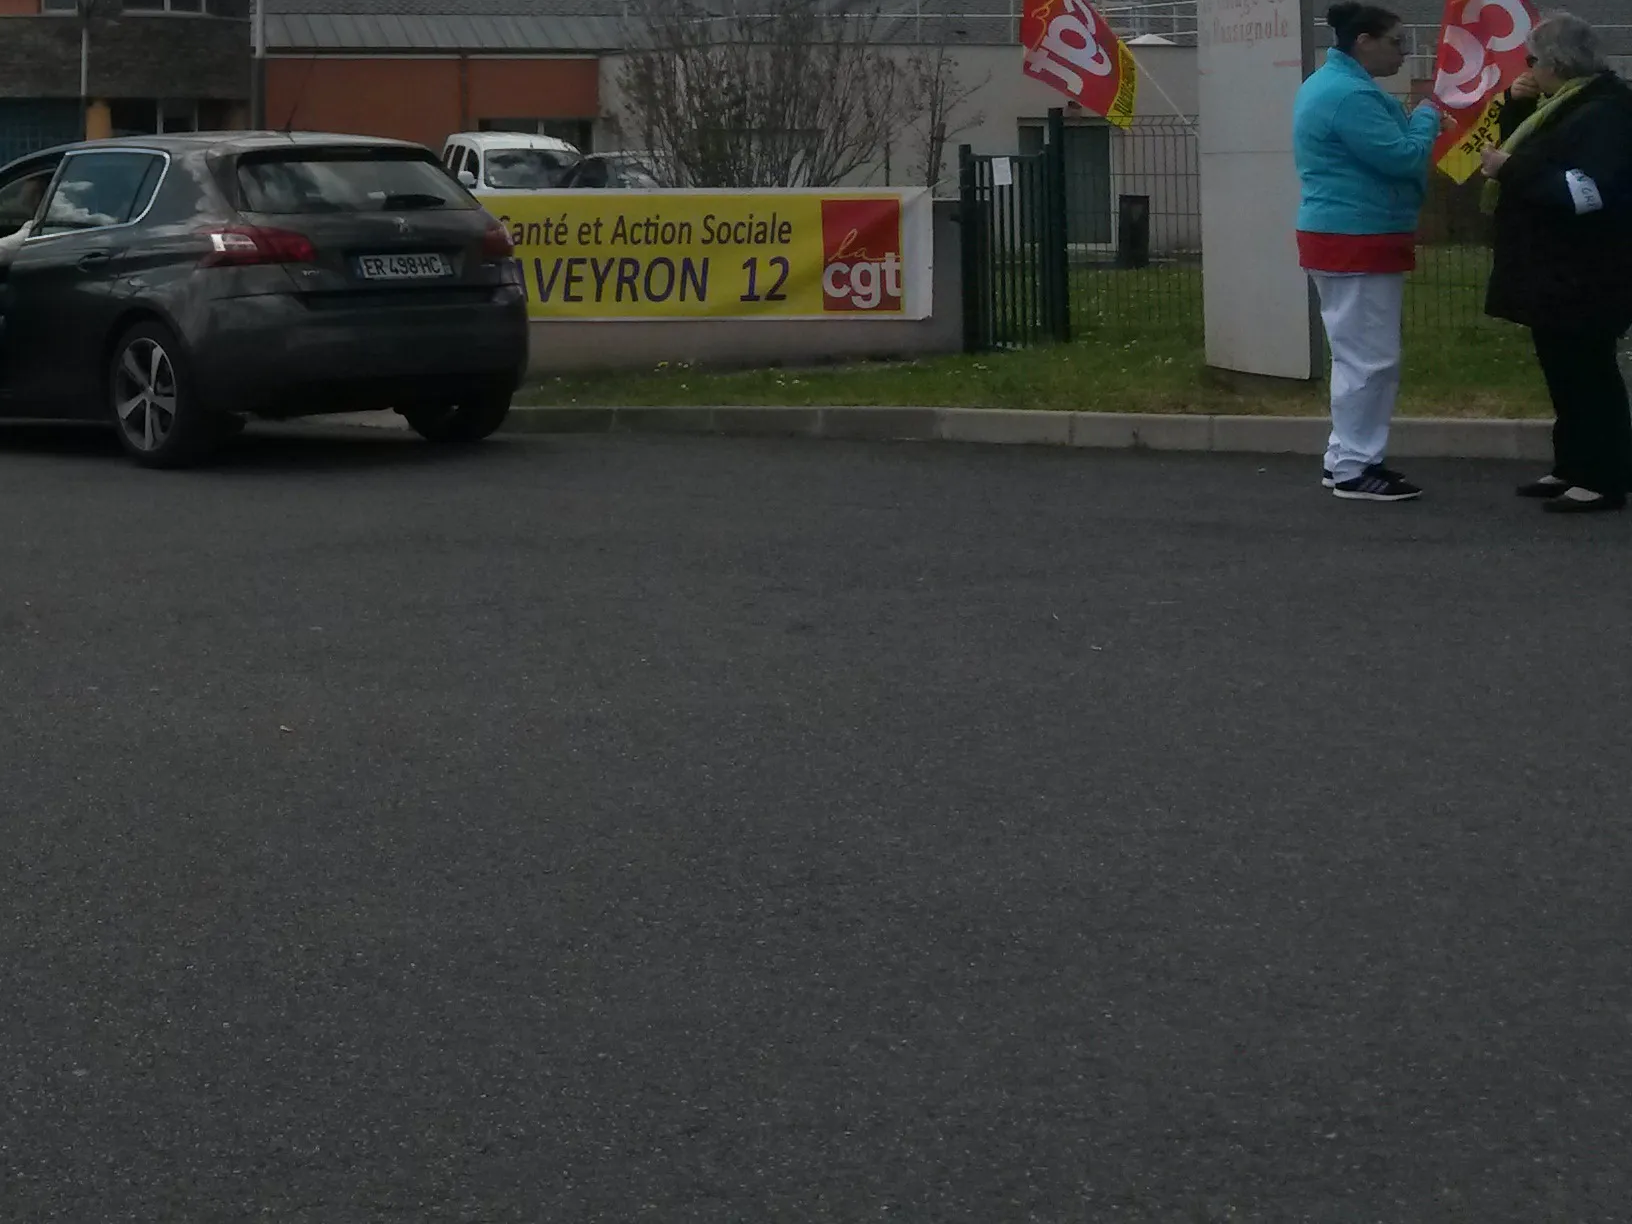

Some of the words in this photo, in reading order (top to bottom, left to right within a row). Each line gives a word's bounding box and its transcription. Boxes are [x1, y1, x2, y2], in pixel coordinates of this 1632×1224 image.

[578, 215, 603, 247] et
[611, 214, 692, 246] Action
[701, 213, 793, 246] Sociale
[828, 228, 877, 263] la
[739, 256, 790, 302] 12
[823, 251, 901, 309] cgt
